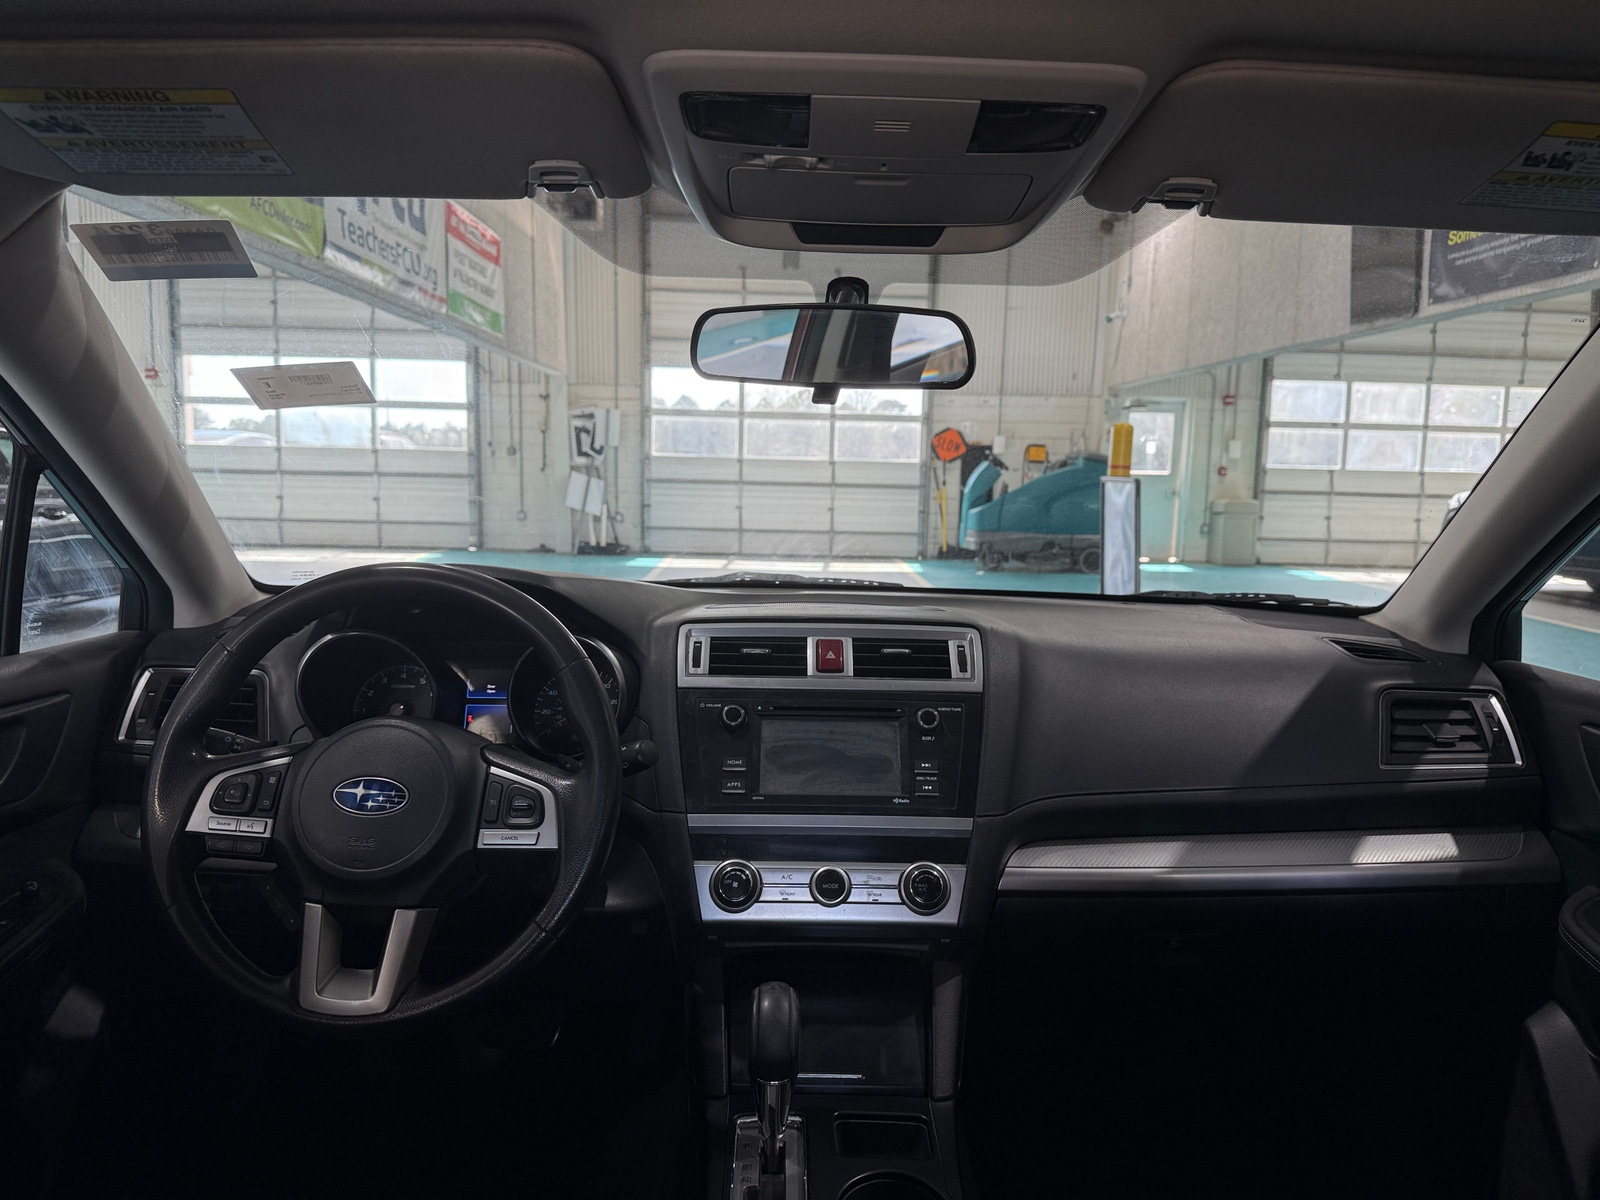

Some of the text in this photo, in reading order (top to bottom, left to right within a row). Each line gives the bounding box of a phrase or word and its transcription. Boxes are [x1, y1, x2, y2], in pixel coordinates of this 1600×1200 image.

[57, 90, 171, 102] WARNING
[85, 140, 248, 150] AVERTISSEMENT
[935, 435, 961, 454] SLOW
